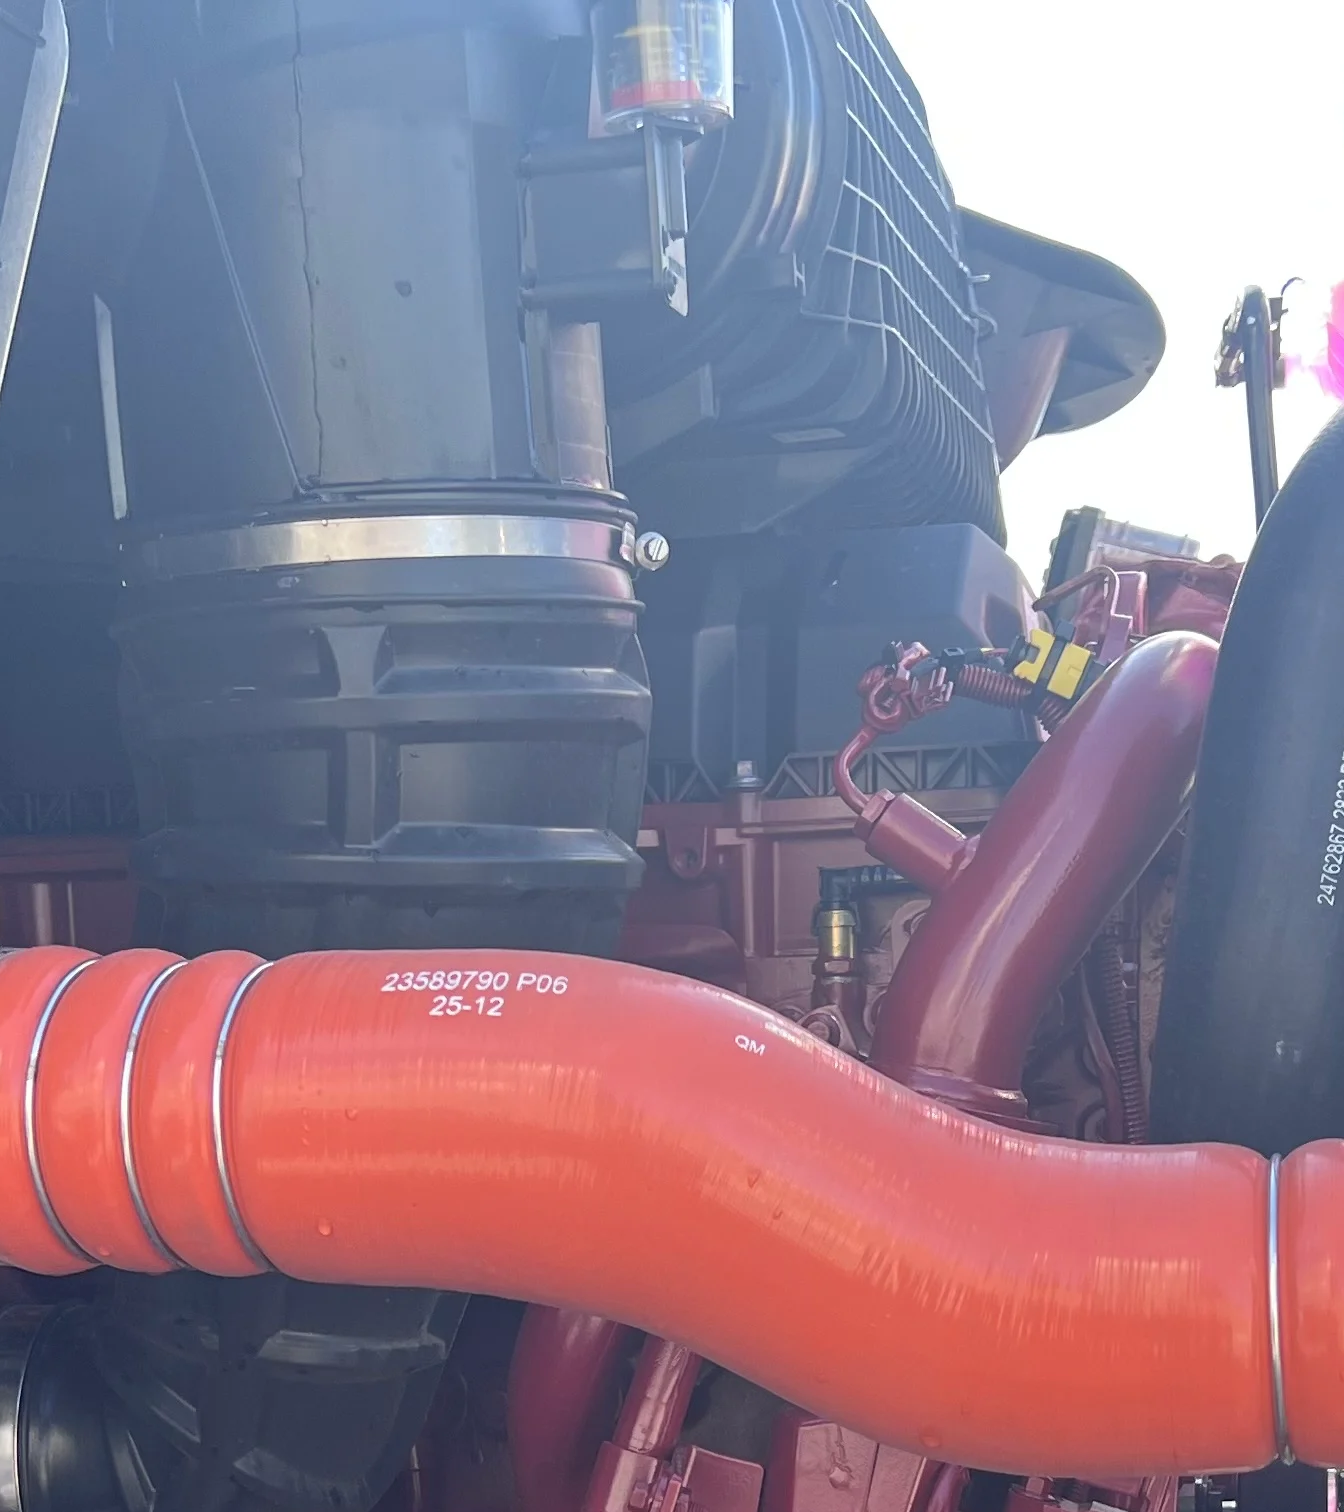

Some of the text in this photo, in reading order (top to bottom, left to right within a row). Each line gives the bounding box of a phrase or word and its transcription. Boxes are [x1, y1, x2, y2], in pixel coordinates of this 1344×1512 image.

[381, 970, 568, 994] 23589790 P06
[429, 995, 504, 1017] 25-12
[734, 1034, 766, 1056] QM
